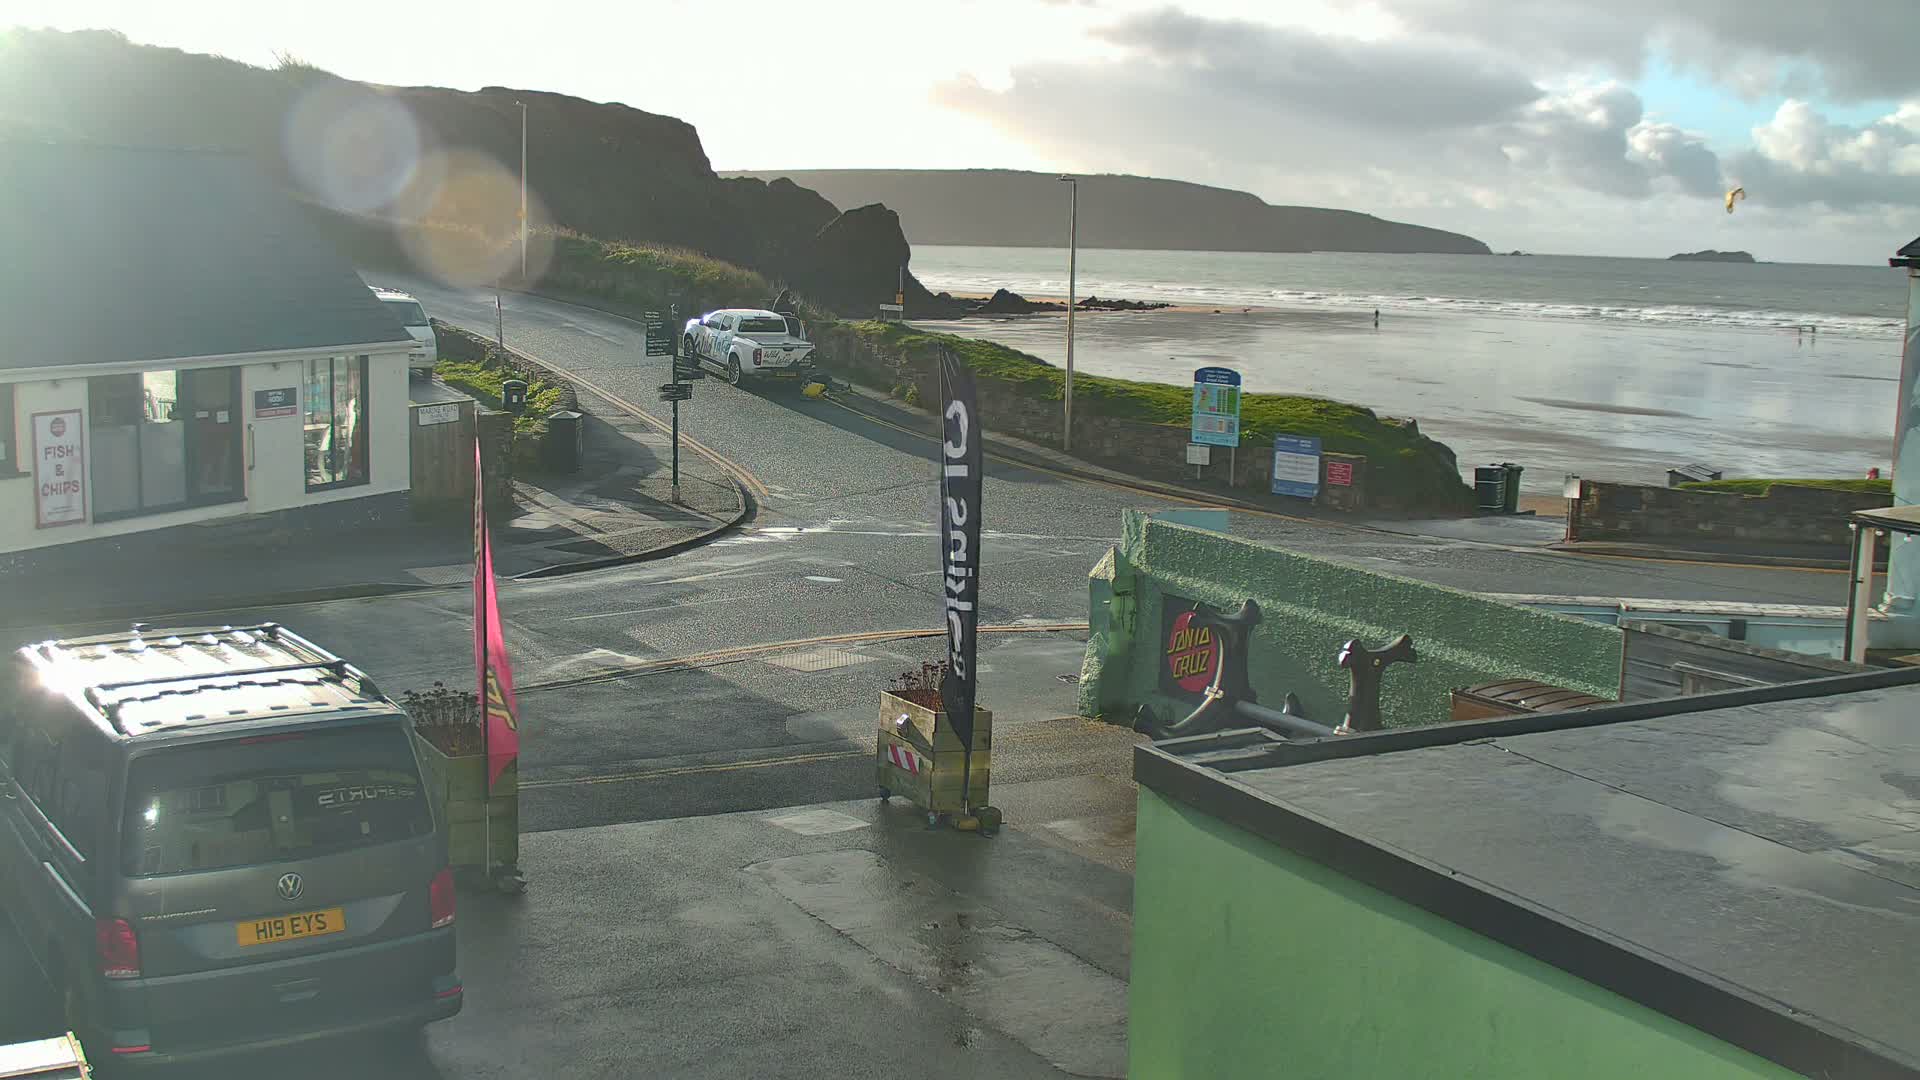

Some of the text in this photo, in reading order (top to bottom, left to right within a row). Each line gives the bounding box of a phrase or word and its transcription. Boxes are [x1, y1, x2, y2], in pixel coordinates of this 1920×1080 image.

[44, 445, 75, 461] FISH
[56, 463, 65, 477] &
[41, 480, 80, 497] CHIPS
[1166, 626, 1211, 655] SANTA
[1173, 649, 1210, 679] CRUZ
[255, 913, 327, 940] H19 EYS
